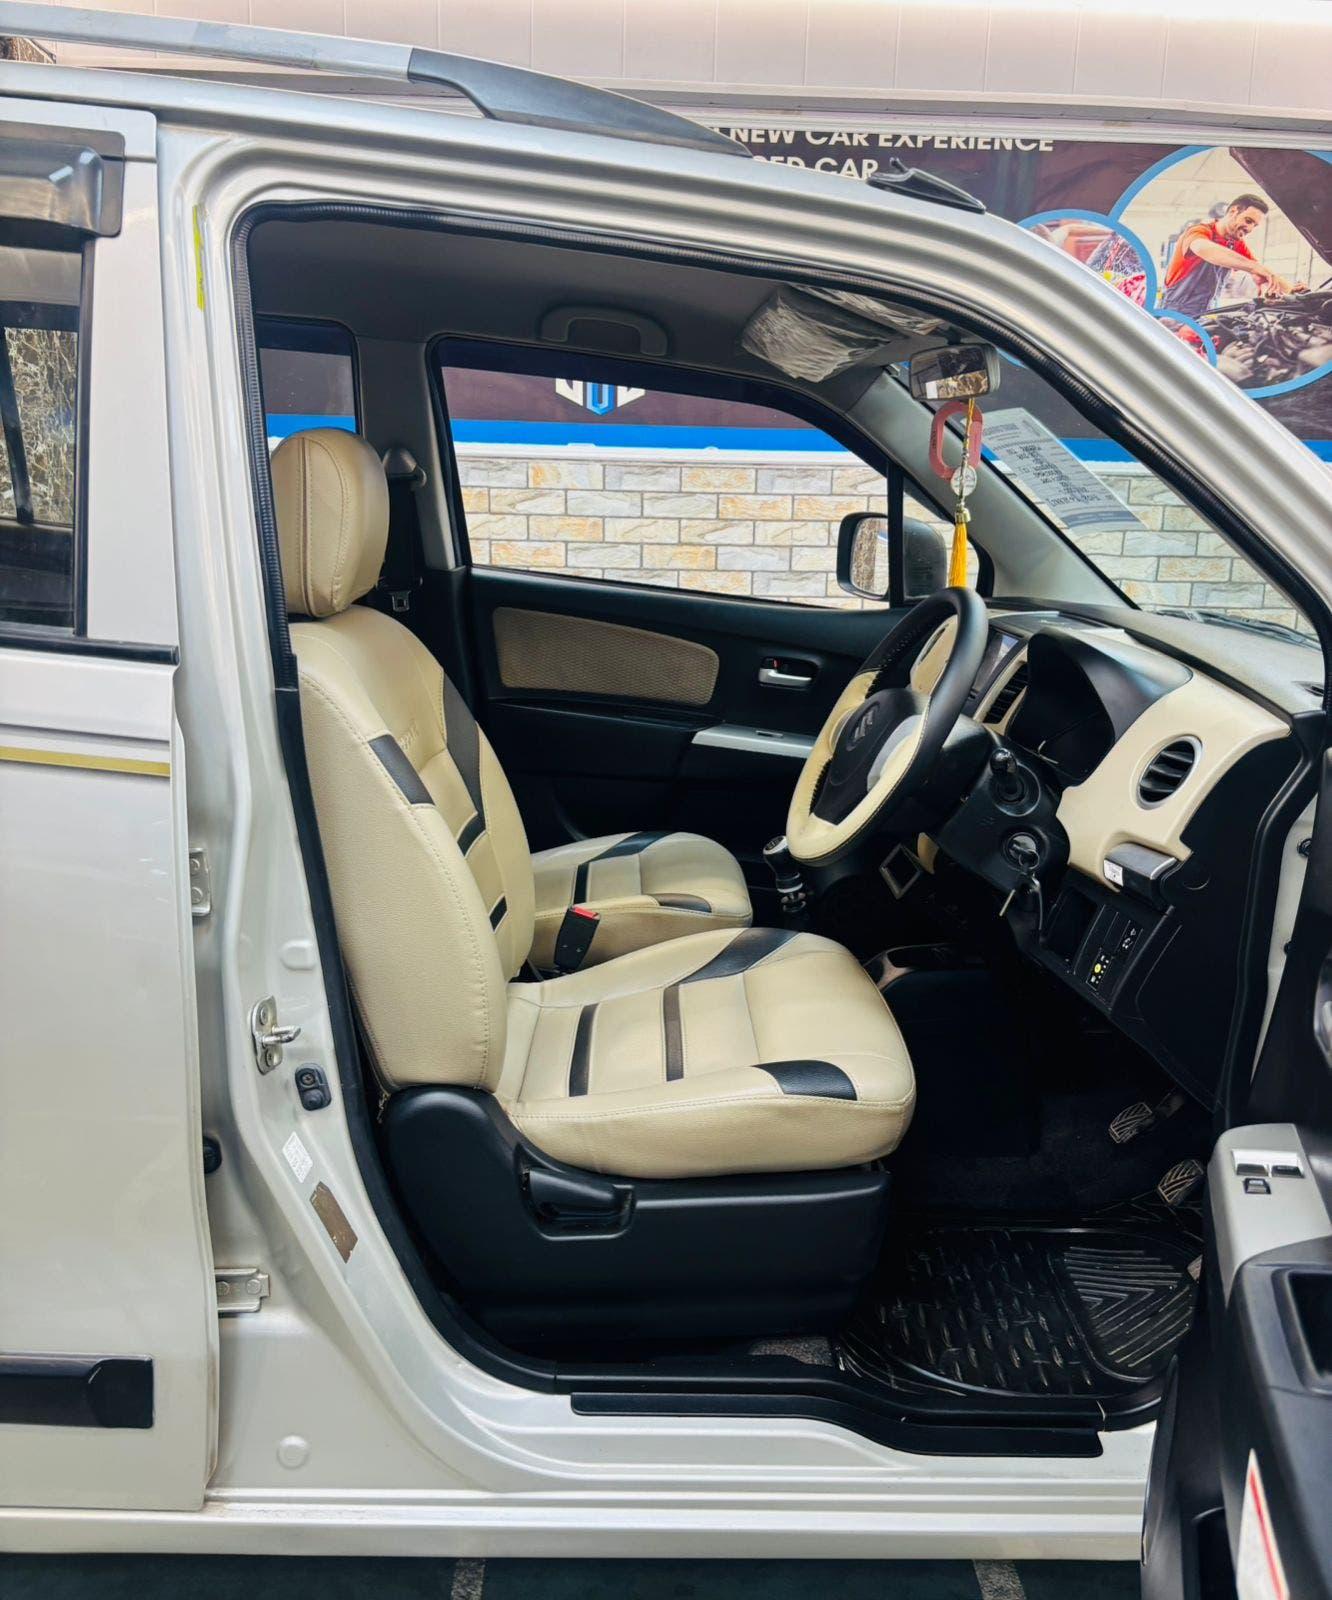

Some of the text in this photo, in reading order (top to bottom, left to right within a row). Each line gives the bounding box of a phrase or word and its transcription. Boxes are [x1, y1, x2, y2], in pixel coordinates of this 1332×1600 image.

[729, 127, 795, 144] NEW
[804, 129, 869, 147] CAR
[878, 135, 1054, 151] EXPERIENCE
